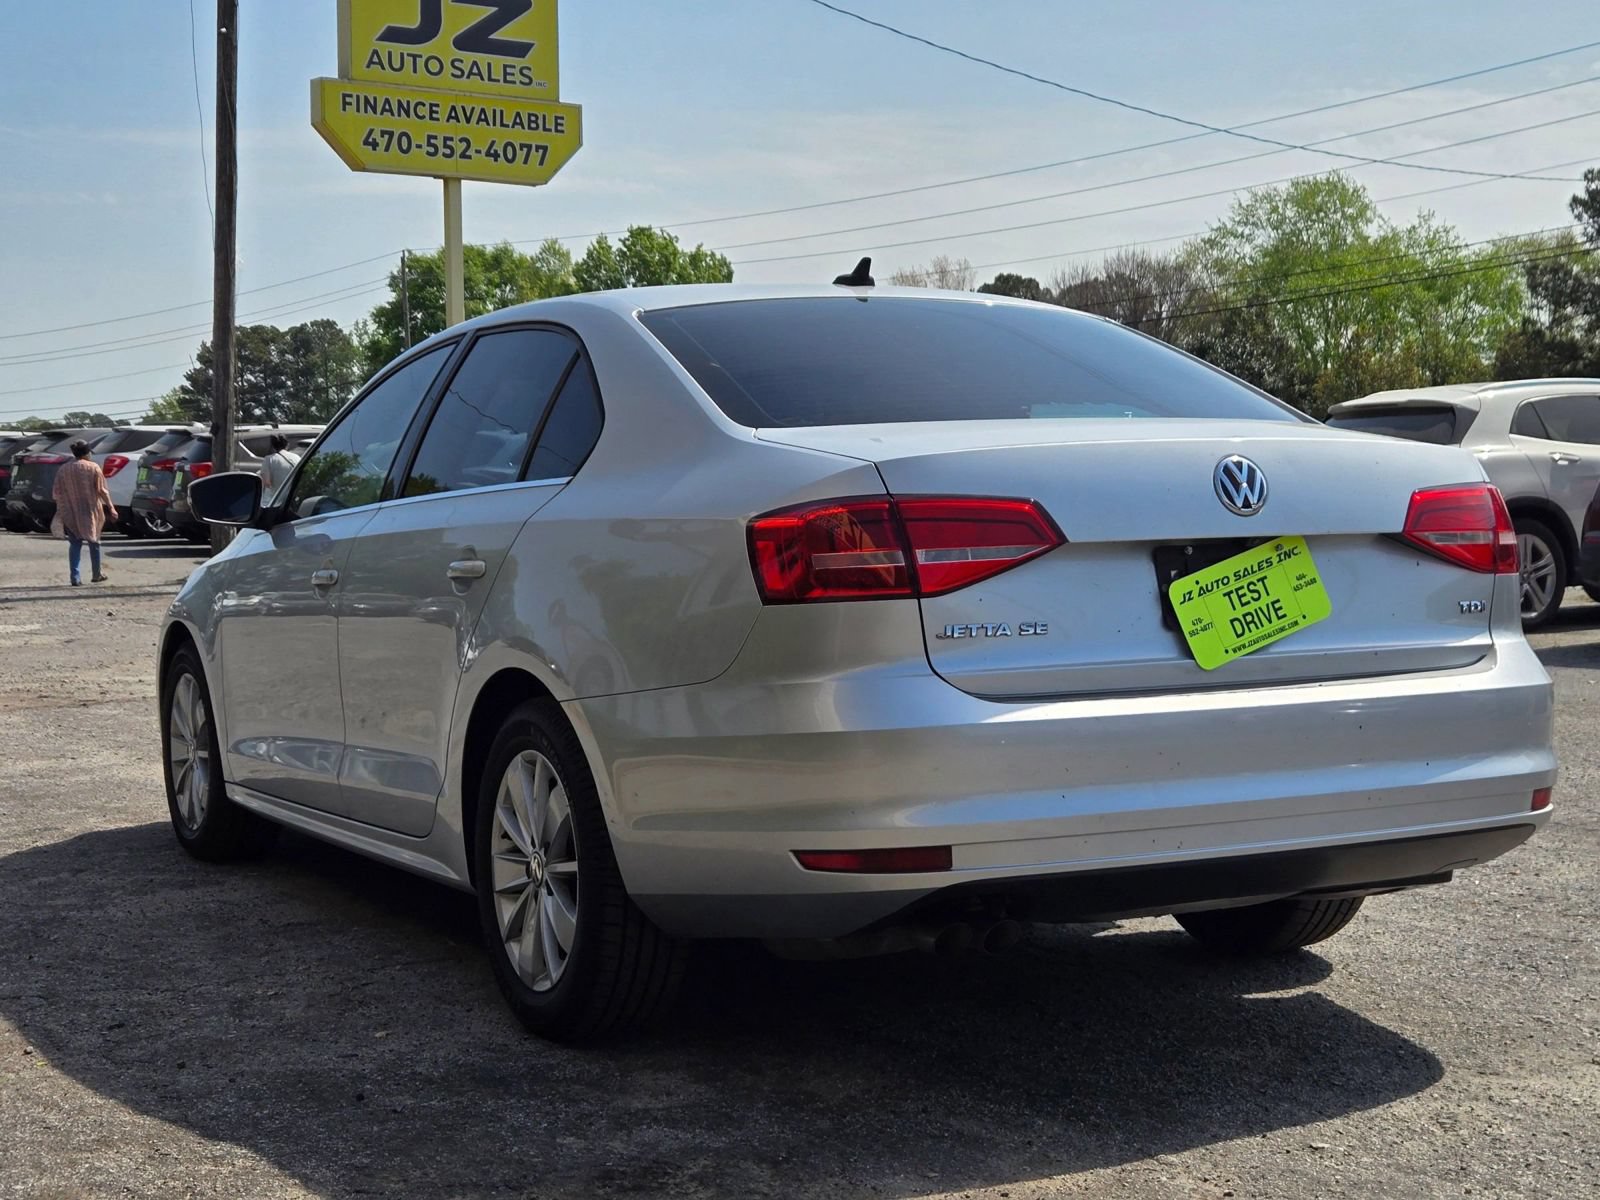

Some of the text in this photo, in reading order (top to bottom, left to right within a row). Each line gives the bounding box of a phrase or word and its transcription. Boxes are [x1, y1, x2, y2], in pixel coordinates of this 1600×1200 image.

[374, 0, 536, 58] JZ
[365, 48, 444, 77] AUTO
[450, 57, 533, 86] SALES
[341, 92, 565, 134] FINANCE AVAILABLE
[361, 127, 549, 167] 470-552-4077
[1179, 590, 1194, 605] JZ
[1197, 575, 1231, 597] AUTO
[1233, 556, 1275, 583] SALES
[1222, 576, 1272, 611] TEST
[1229, 598, 1288, 639] DRIVE
[1458, 599, 1487, 614] TDI
[936, 621, 1048, 640] JETTA SE
